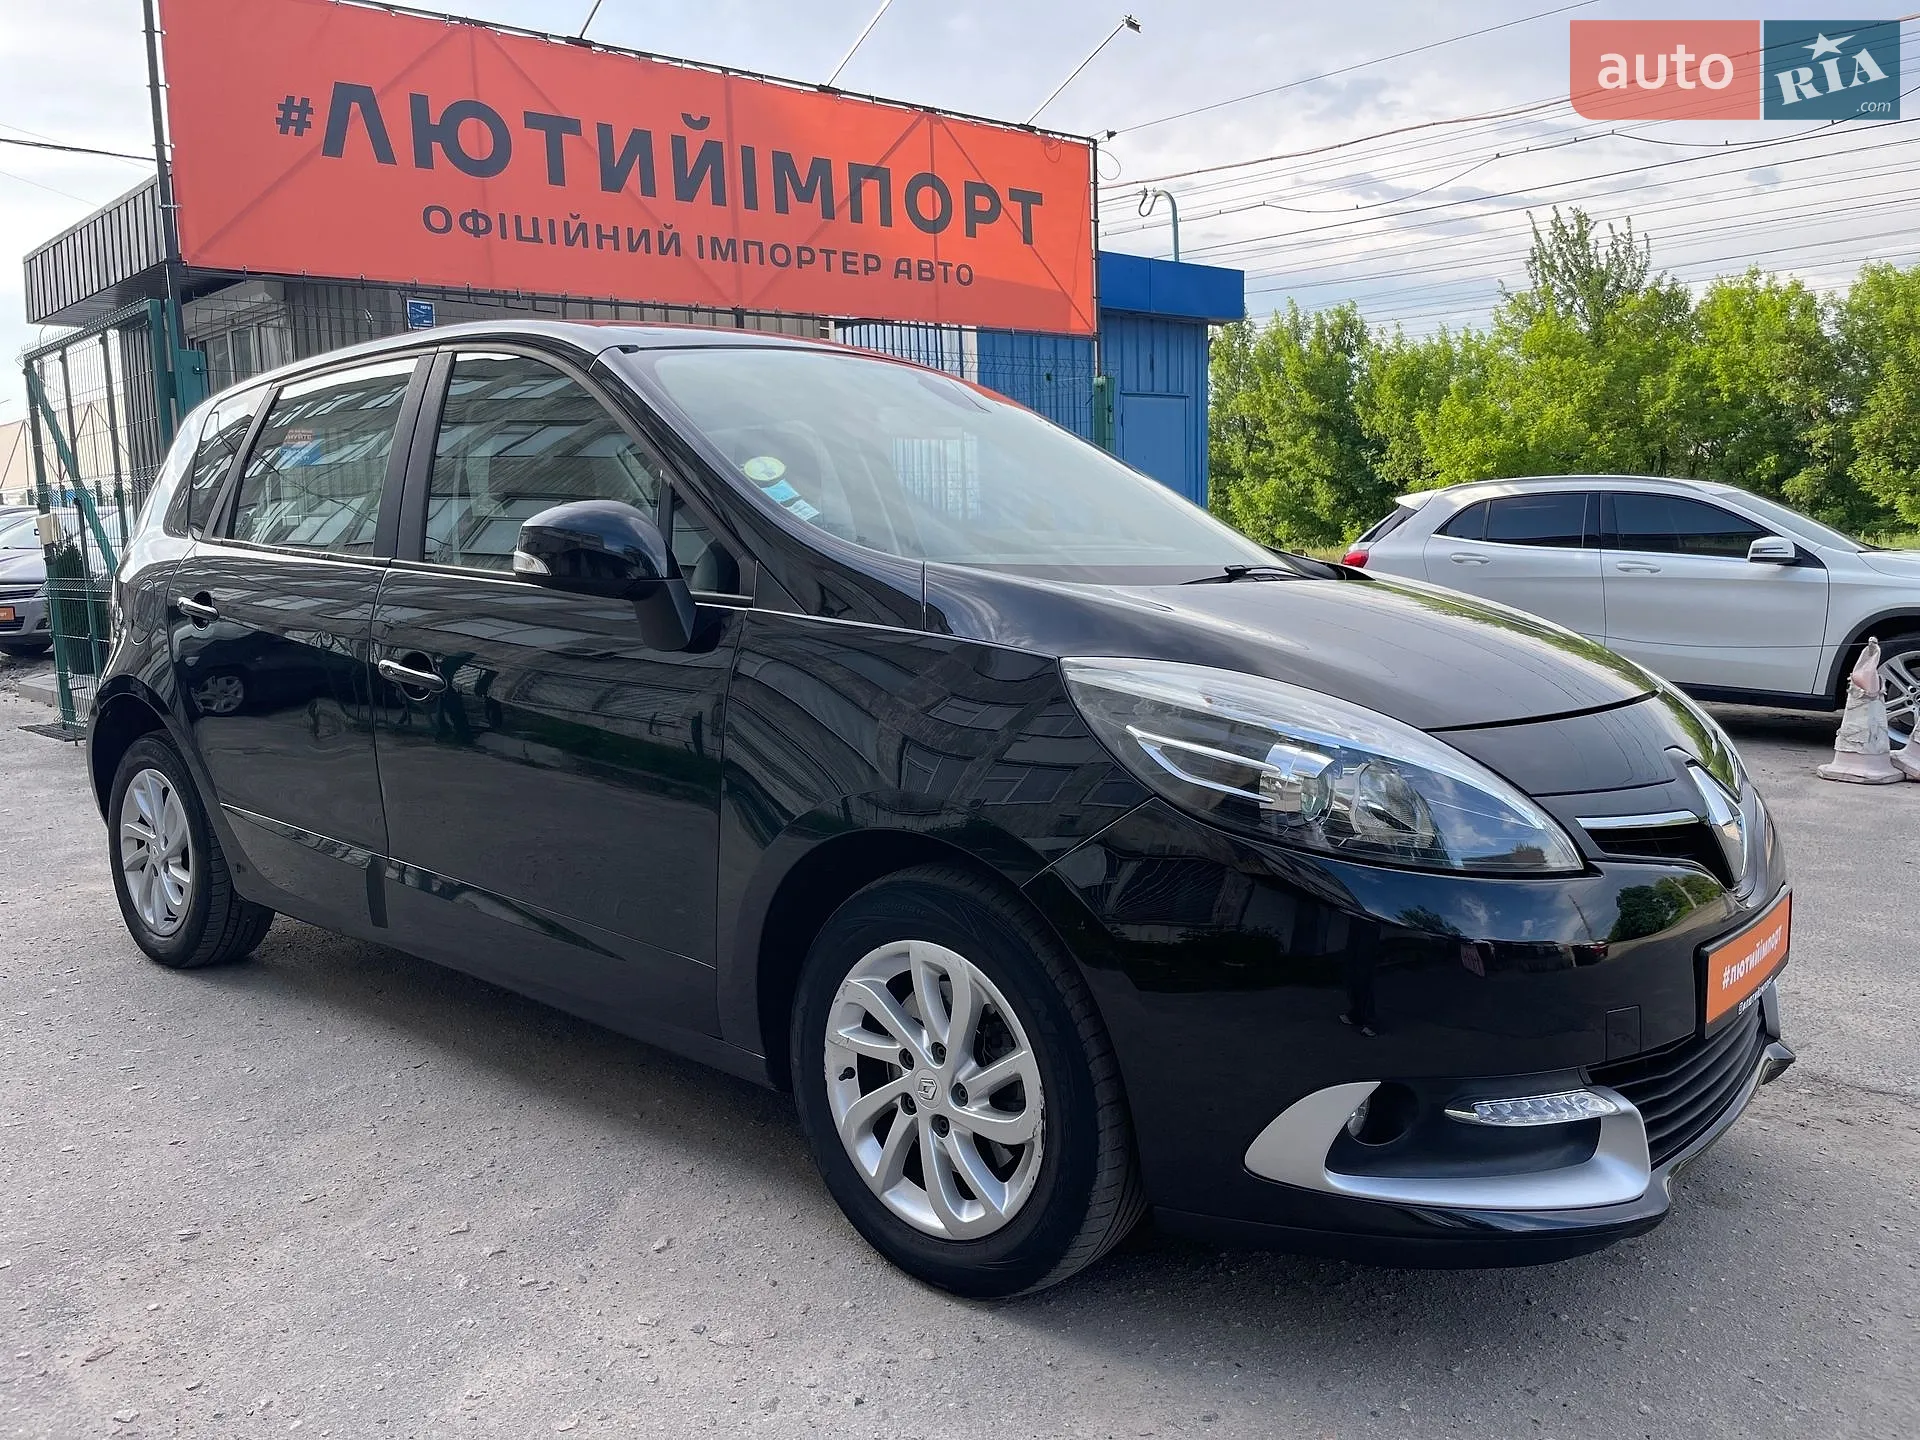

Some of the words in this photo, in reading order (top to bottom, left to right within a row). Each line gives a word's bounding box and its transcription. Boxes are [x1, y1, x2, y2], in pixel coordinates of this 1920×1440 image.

[275, 81, 1043, 246] #ЛЮТИЙІМПОРТ
[422, 204, 682, 258] ОФІЦІЙНИЙ
[697, 234, 882, 277] ІМПОРТЕР
[893, 257, 974, 287] АВТО
